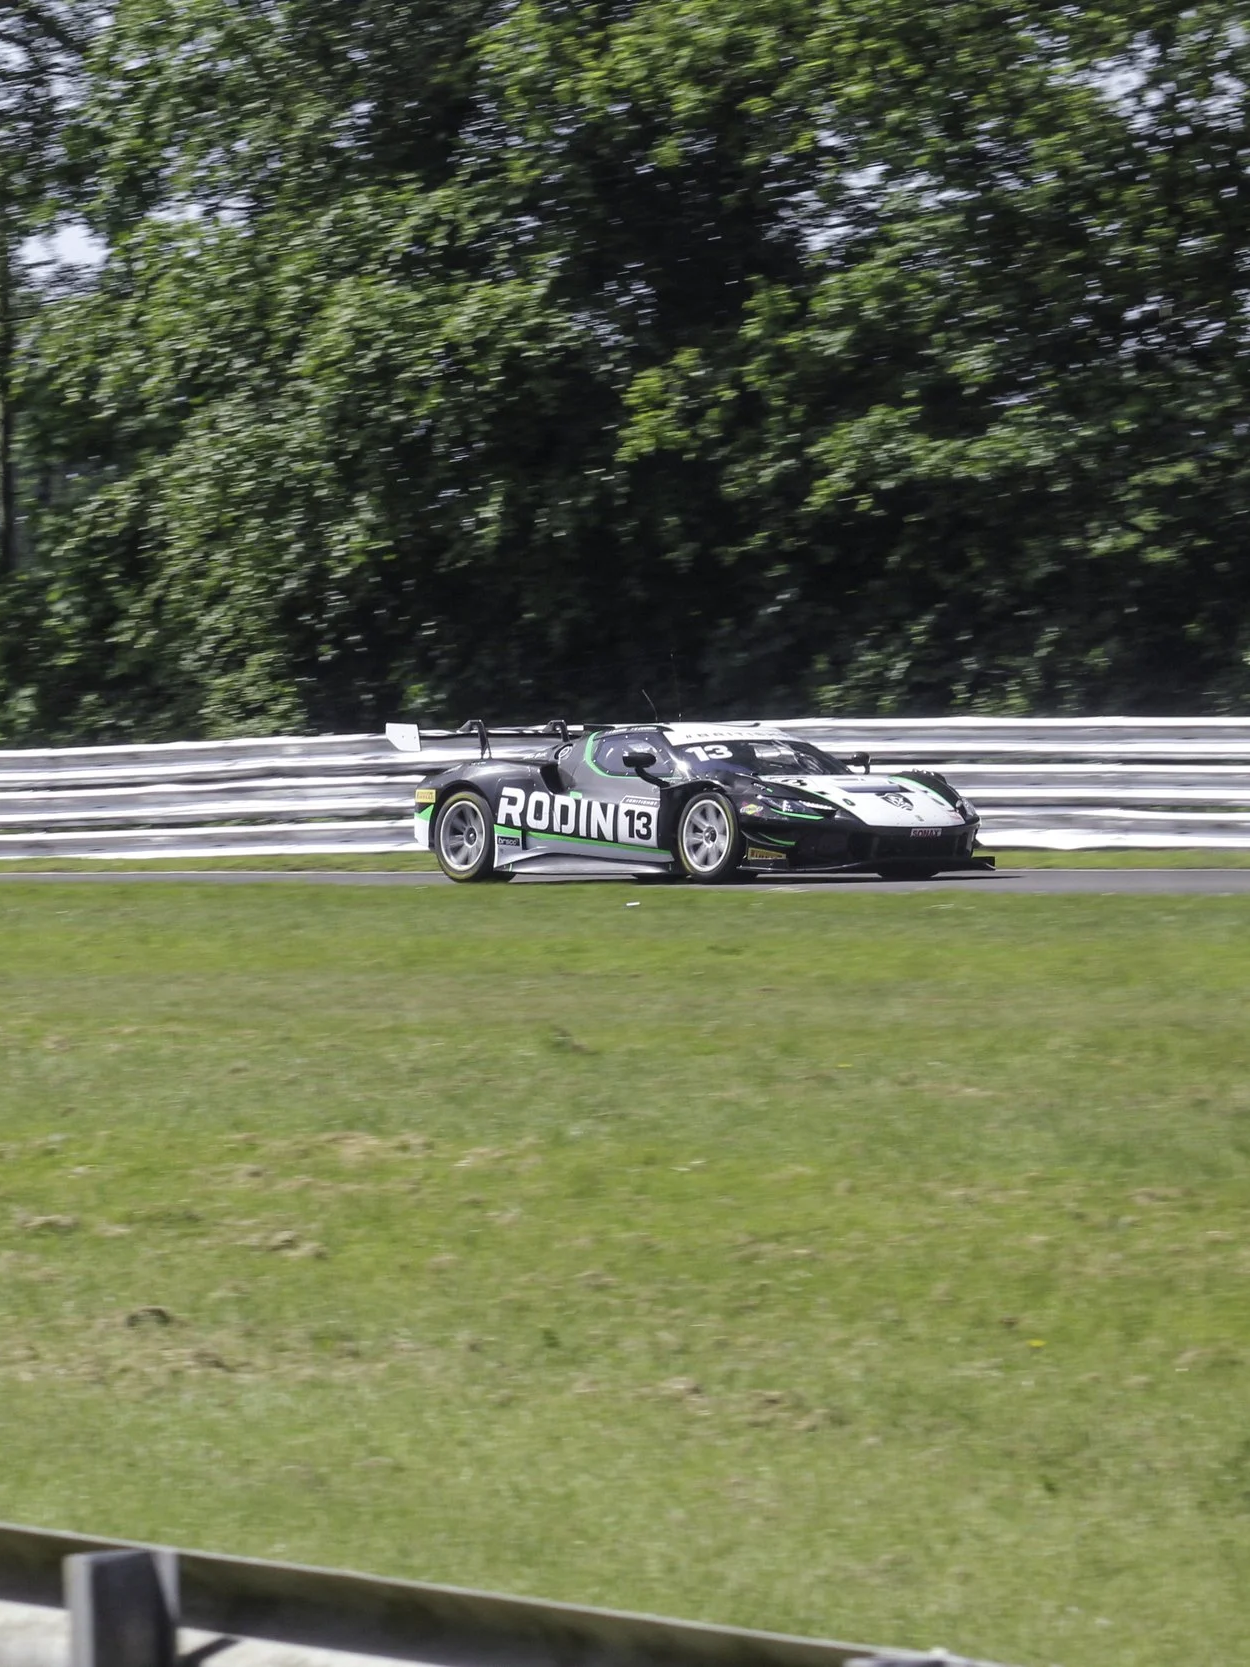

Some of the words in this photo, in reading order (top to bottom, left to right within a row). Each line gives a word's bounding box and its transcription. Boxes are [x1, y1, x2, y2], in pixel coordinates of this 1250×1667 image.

[685, 745, 733, 762] 13
[497, 787, 615, 841] RODIN
[624, 809, 652, 840] 13
